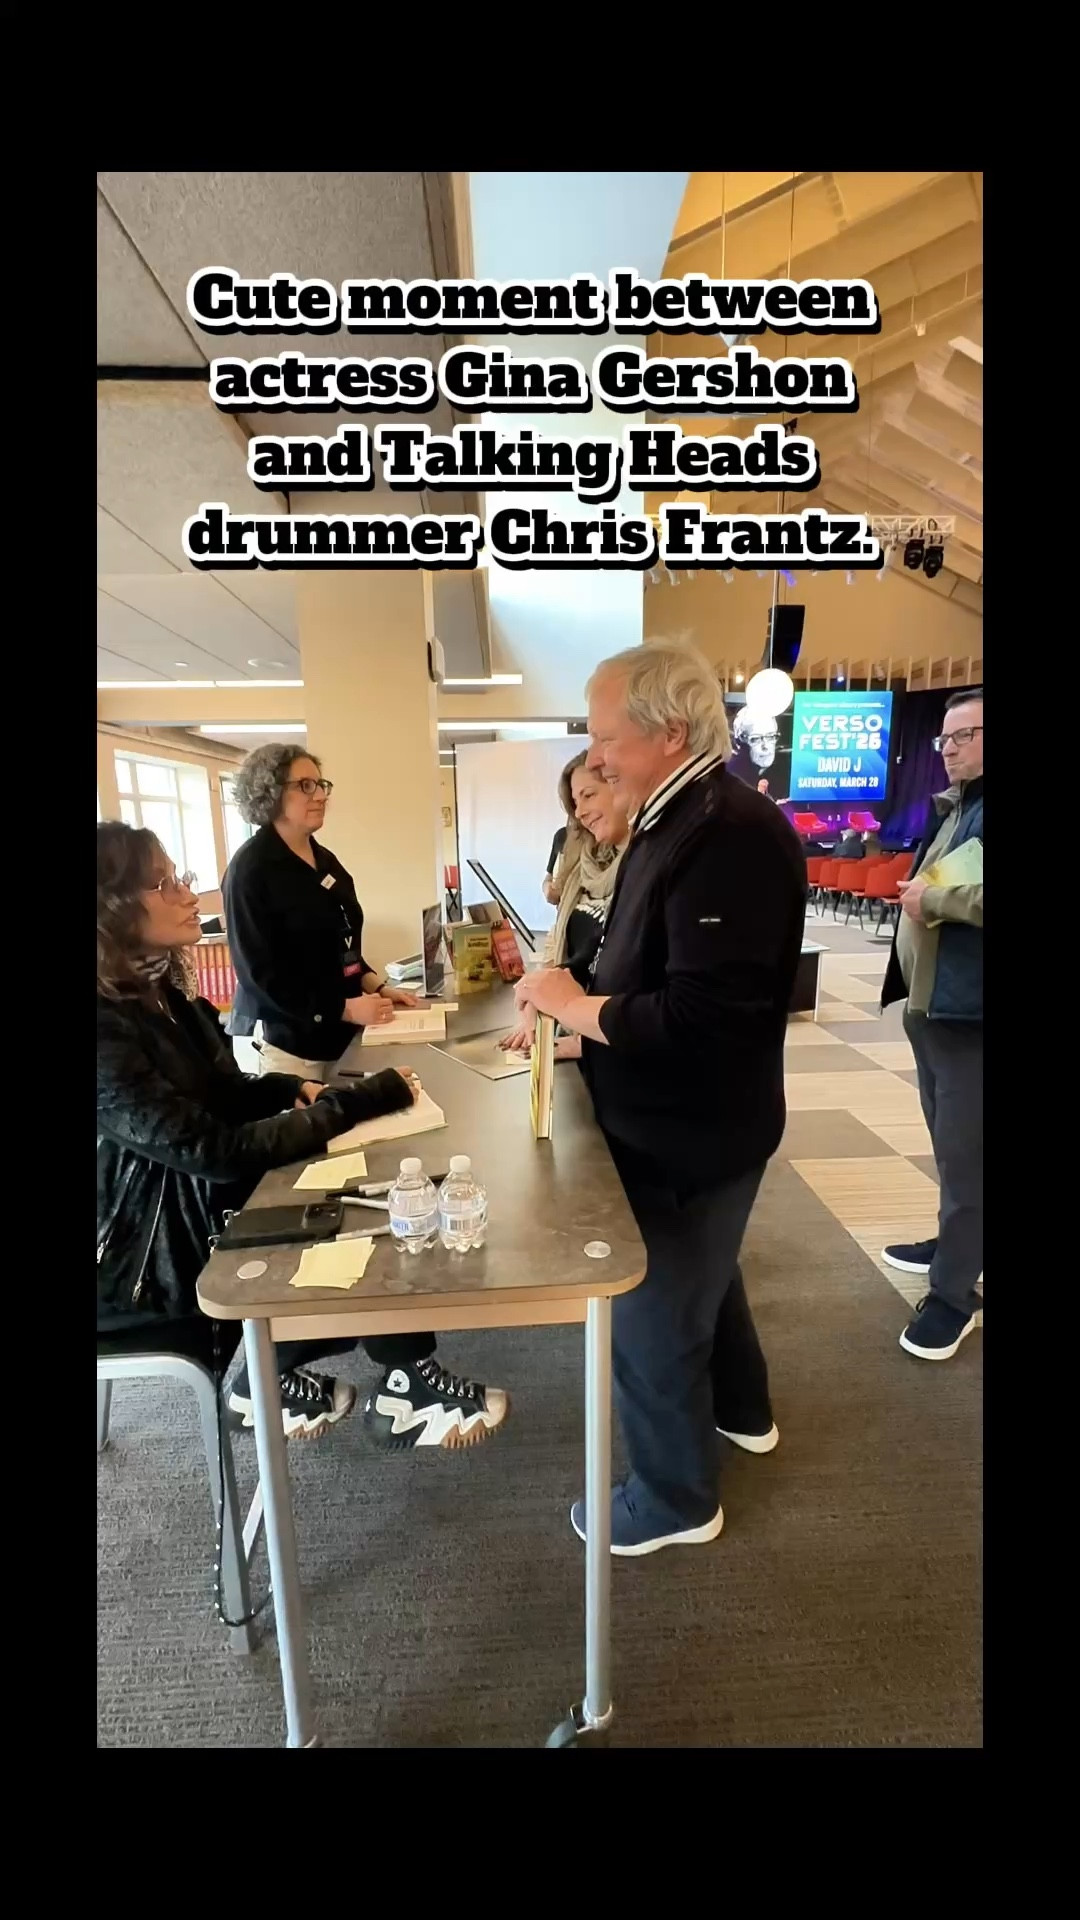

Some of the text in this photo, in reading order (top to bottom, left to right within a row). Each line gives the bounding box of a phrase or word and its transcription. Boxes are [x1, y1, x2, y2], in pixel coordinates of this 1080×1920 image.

[801, 714, 883, 732] VERSO
[799, 732, 882, 750] FEST'26
[817, 757, 862, 773] DAVID J
[839, 777, 867, 788] MARCH
